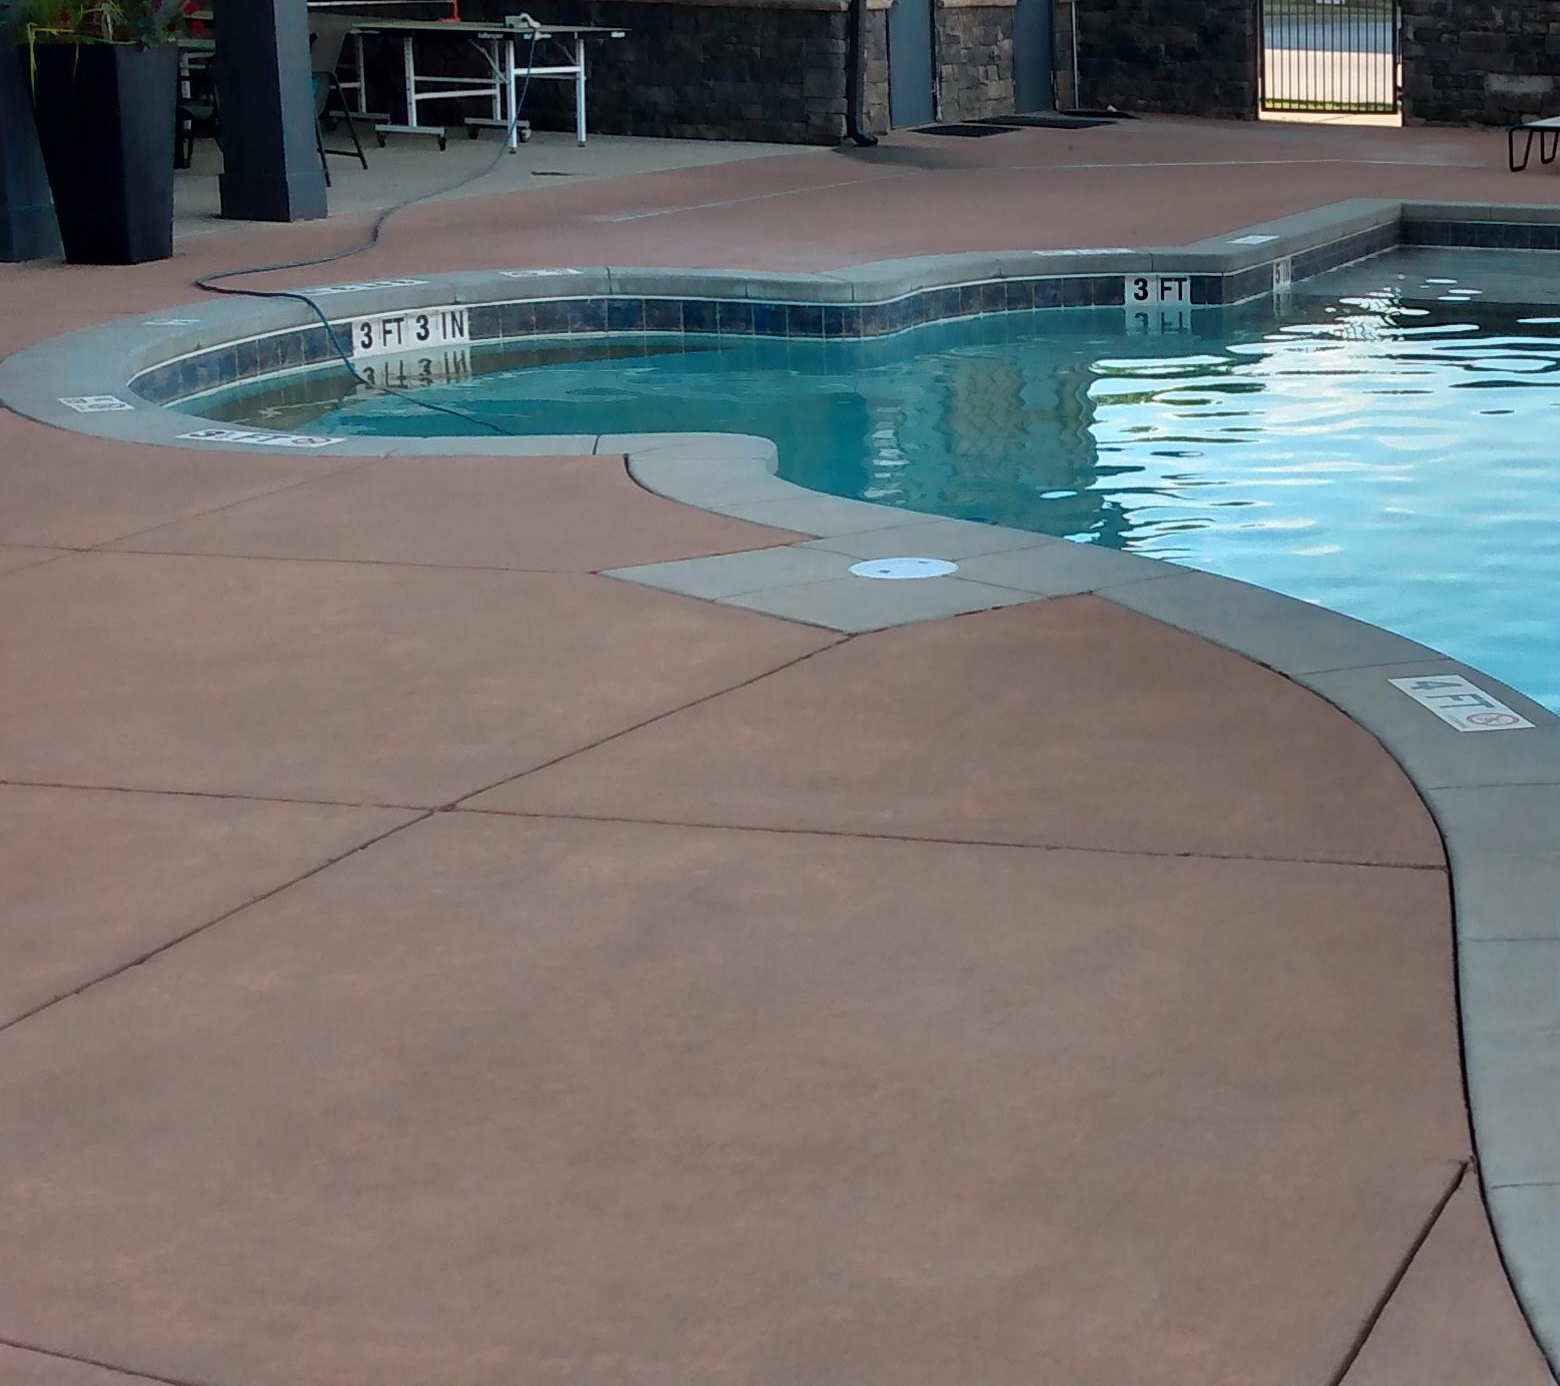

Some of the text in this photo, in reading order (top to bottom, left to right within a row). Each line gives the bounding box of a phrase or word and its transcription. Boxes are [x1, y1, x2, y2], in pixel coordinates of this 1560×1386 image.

[1133, 277, 1187, 301] 3 FT
[360, 311, 464, 349] 3 FT 3 IN
[1411, 680, 1496, 709] 4 FT
